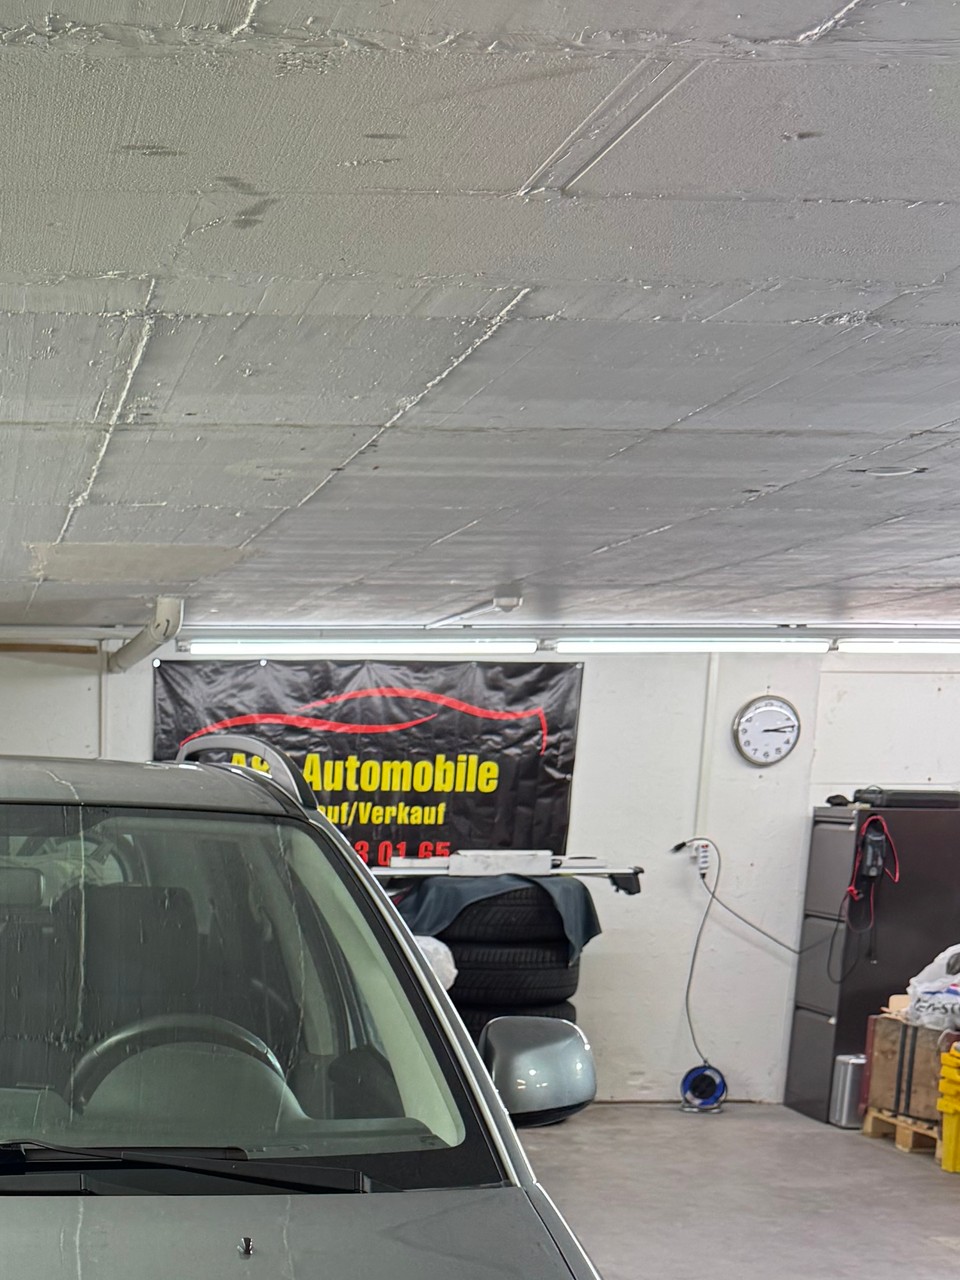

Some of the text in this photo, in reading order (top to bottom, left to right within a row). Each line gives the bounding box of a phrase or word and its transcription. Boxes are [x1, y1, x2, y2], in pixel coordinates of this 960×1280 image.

[303, 752, 499, 793] Automobile
[377, 840, 407, 867] 01
[418, 840, 451, 860] 65
